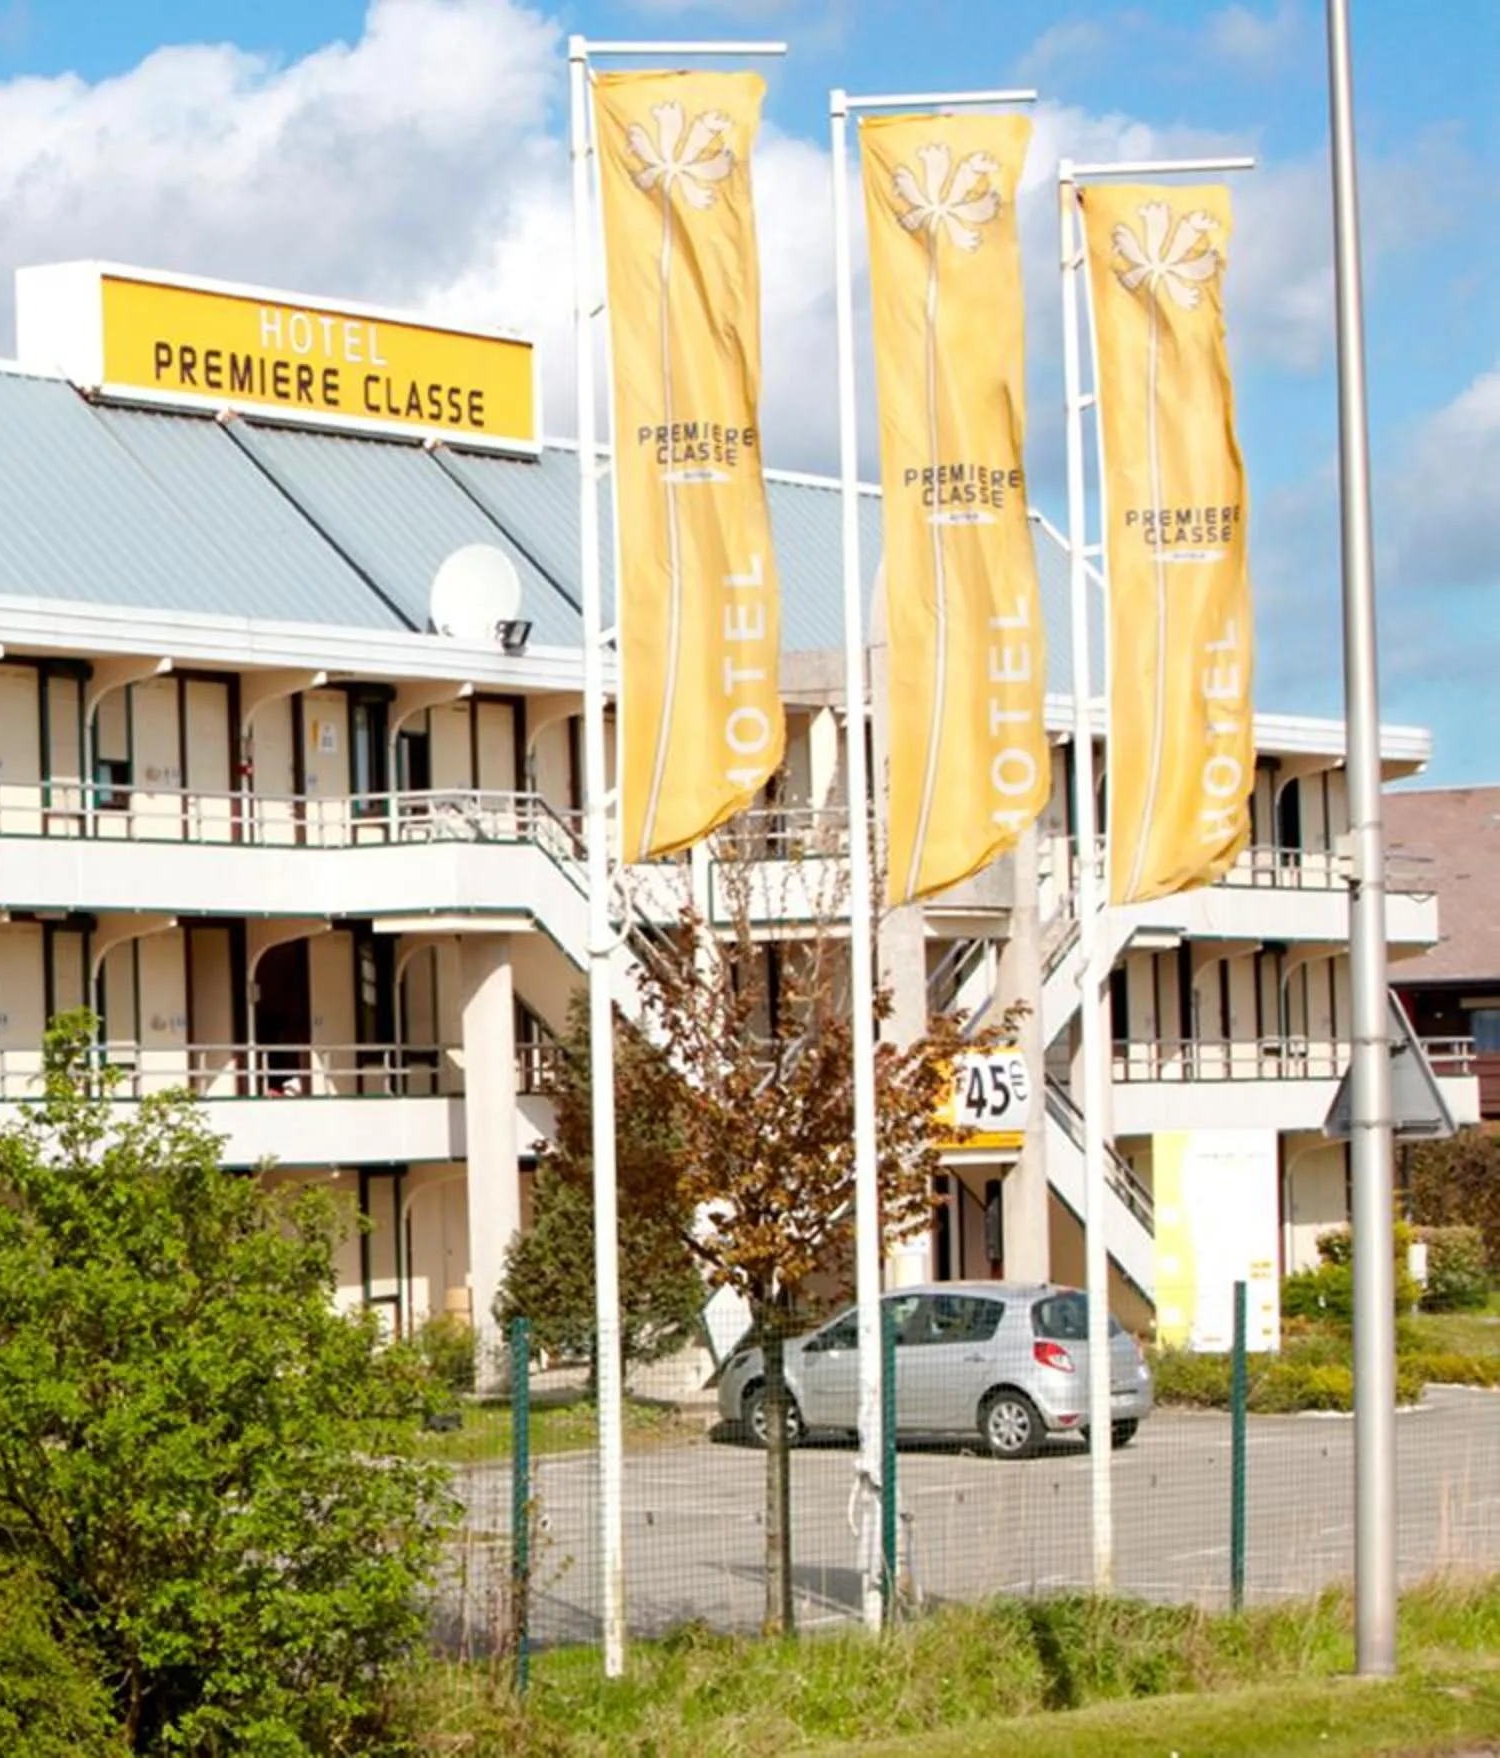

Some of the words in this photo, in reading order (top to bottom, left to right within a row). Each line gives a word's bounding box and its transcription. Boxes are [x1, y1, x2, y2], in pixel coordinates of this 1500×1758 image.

[260, 308, 388, 366] HOTEL
[155, 341, 340, 406] PREMIERE
[364, 375, 485, 427] CLASSE
[638, 421, 756, 447] PREMIERE
[657, 442, 737, 467] CLASSE
[903, 463, 1020, 489] PREMIERE
[922, 483, 1004, 509] CLASSE
[1144, 525, 1232, 545] CLASSE
